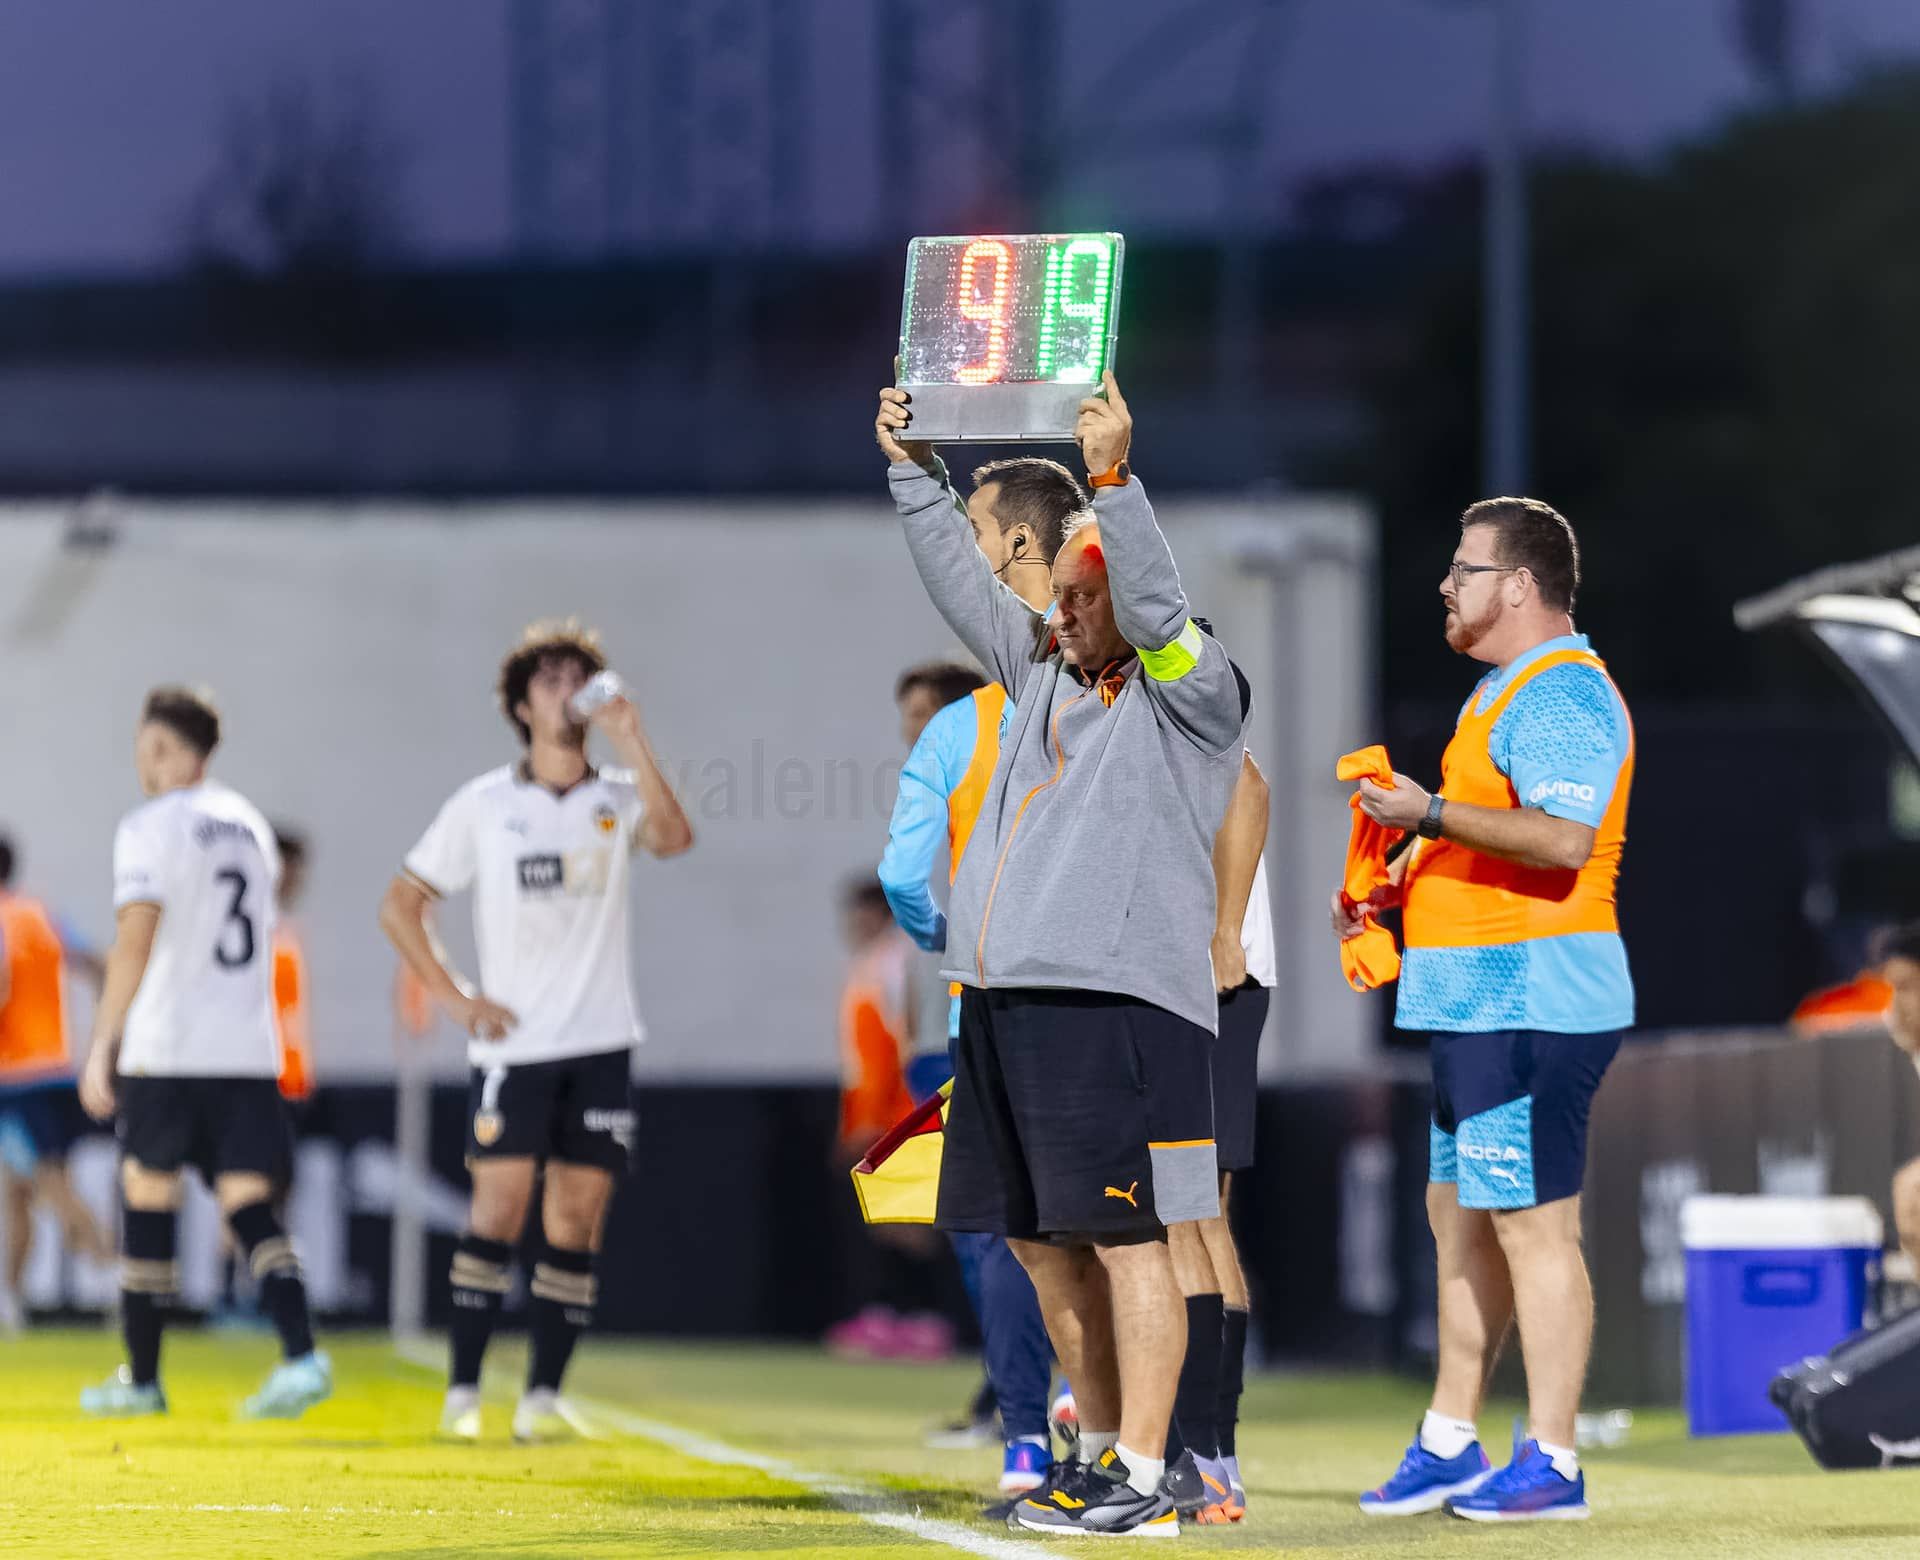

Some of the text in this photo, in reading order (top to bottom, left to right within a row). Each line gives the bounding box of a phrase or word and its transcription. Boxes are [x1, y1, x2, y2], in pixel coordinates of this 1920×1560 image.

[956, 239, 1111, 384] 9 19
[1528, 779, 1594, 803] divina
[213, 866, 255, 967] 3
